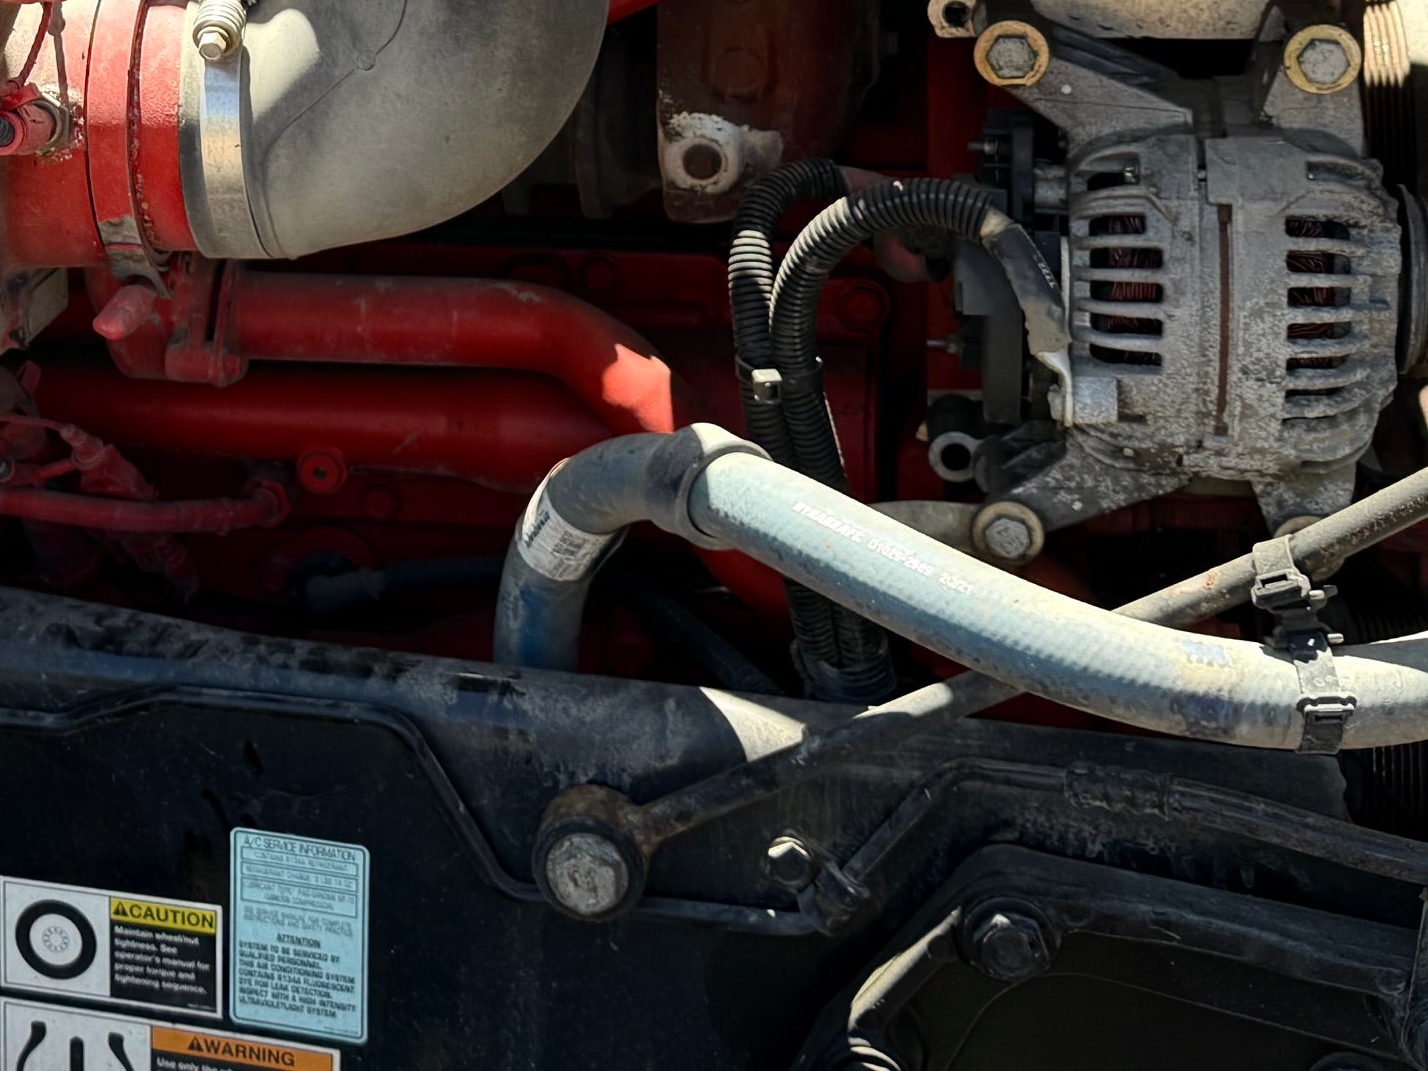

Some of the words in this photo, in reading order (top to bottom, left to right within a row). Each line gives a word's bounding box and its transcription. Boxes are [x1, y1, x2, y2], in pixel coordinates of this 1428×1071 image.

[243, 835, 262, 849] A/C
[264, 838, 297, 852] SERVICE
[299, 843, 356, 861] INFORMATION
[129, 904, 214, 929] CAUTION
[114, 925, 153, 939] Maintain
[276, 933, 321, 948] ATTENTION
[160, 943, 178, 955] See
[239, 940, 268, 951] SYSTEM
[270, 945, 279, 953] TO
[281, 947, 290, 955] BE
[292, 948, 328, 961] SERVICED
[239, 949, 275, 962] QUALIFIED
[114, 962, 144, 974] proper
[146, 966, 177, 979] torque
[178, 971, 196, 981] and
[162, 957, 196, 969] manual
[197, 961, 210, 971] for
[114, 973, 160, 989] tightening
[239, 967, 275, 980] CONTAINS
[270, 963, 324, 979] CONDITIONING
[325, 972, 355, 984] SYSTEM
[203, 1037, 295, 1067] WARNING
[157, 1057, 176, 1069] Use
